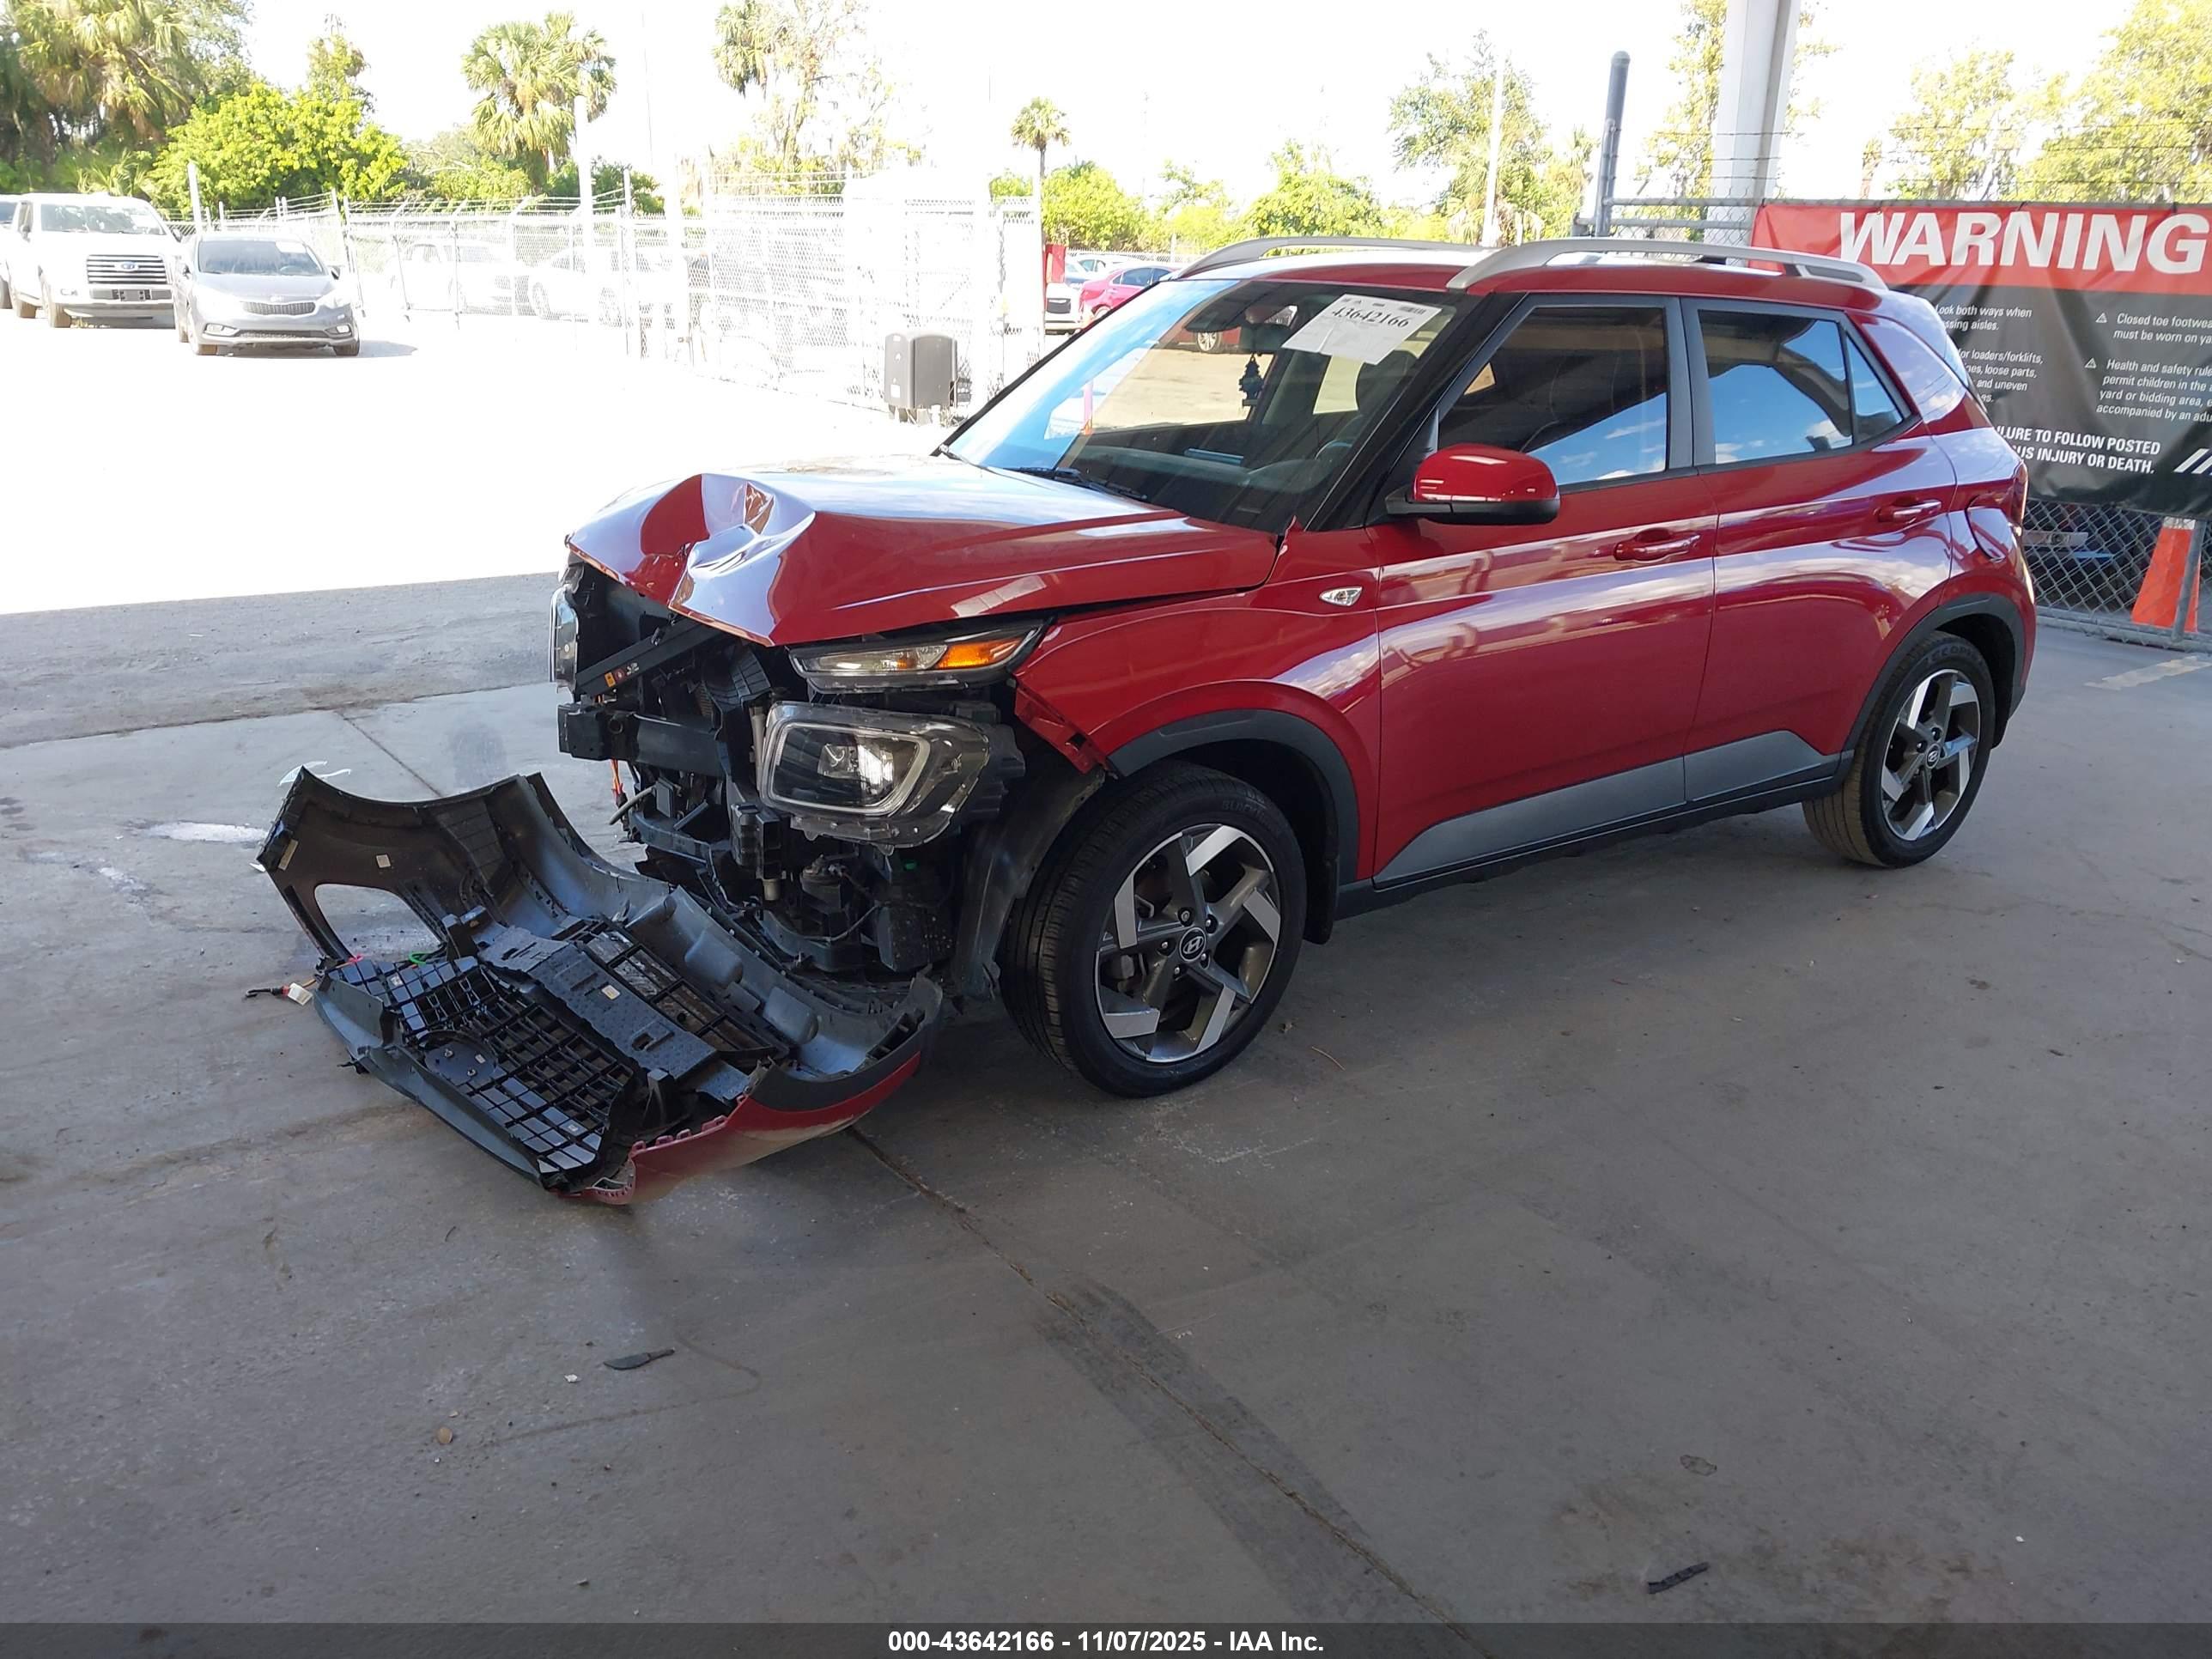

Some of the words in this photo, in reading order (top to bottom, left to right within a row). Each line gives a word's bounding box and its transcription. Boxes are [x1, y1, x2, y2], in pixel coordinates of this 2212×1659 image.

[1840, 211, 2210, 274] WARNING
[1332, 307, 1409, 327] 43642166
[1955, 305, 1978, 316] both
[1979, 307, 2004, 318] ways
[2006, 307, 2033, 318] when
[1944, 319, 1969, 331] ssing
[1971, 319, 1999, 331] aisles.
[2117, 313, 2151, 325] Closed
[2153, 316, 2169, 326] toe
[2171, 315, 2212, 329] footwea
[2113, 330, 2139, 340] must
[2140, 329, 2153, 341] be
[2155, 333, 2182, 343] worn
[2184, 334, 2197, 343] on
[2200, 334, 2212, 346] ya
[1972, 349, 2044, 364] loaders/forklifts,
[1984, 364, 2009, 375] loose
[2011, 367, 2037, 379] parts,
[2106, 359, 2139, 372] Health
[2140, 362, 2160, 373] and
[2160, 363, 2193, 377] safety
[2194, 364, 2212, 377] rule
[1977, 378, 1993, 389] and
[1995, 381, 2027, 391] uneven
[2102, 374, 2135, 386] permit
[2136, 377, 2176, 389] children
[2178, 378, 2188, 390] in
[2190, 380, 2207, 392] the
[2100, 389, 2124, 400] yard
[2124, 392, 2137, 401] or
[2139, 391, 2177, 406] bidding
[2179, 397, 2203, 409] area,
[2096, 404, 2164, 418] accompanied
[2164, 408, 2178, 421] by
[2179, 411, 2191, 420] an
[2192, 410, 2212, 422] adu
[1996, 425, 2033, 441] ILURE
[2035, 428, 2051, 443] TO
[2054, 431, 2106, 450] FOLLOW
[2106, 437, 2160, 455] POSTED
[2037, 447, 2085, 465] INJURY
[2087, 453, 2106, 468] OR
[2108, 456, 2155, 474] DEATH.
